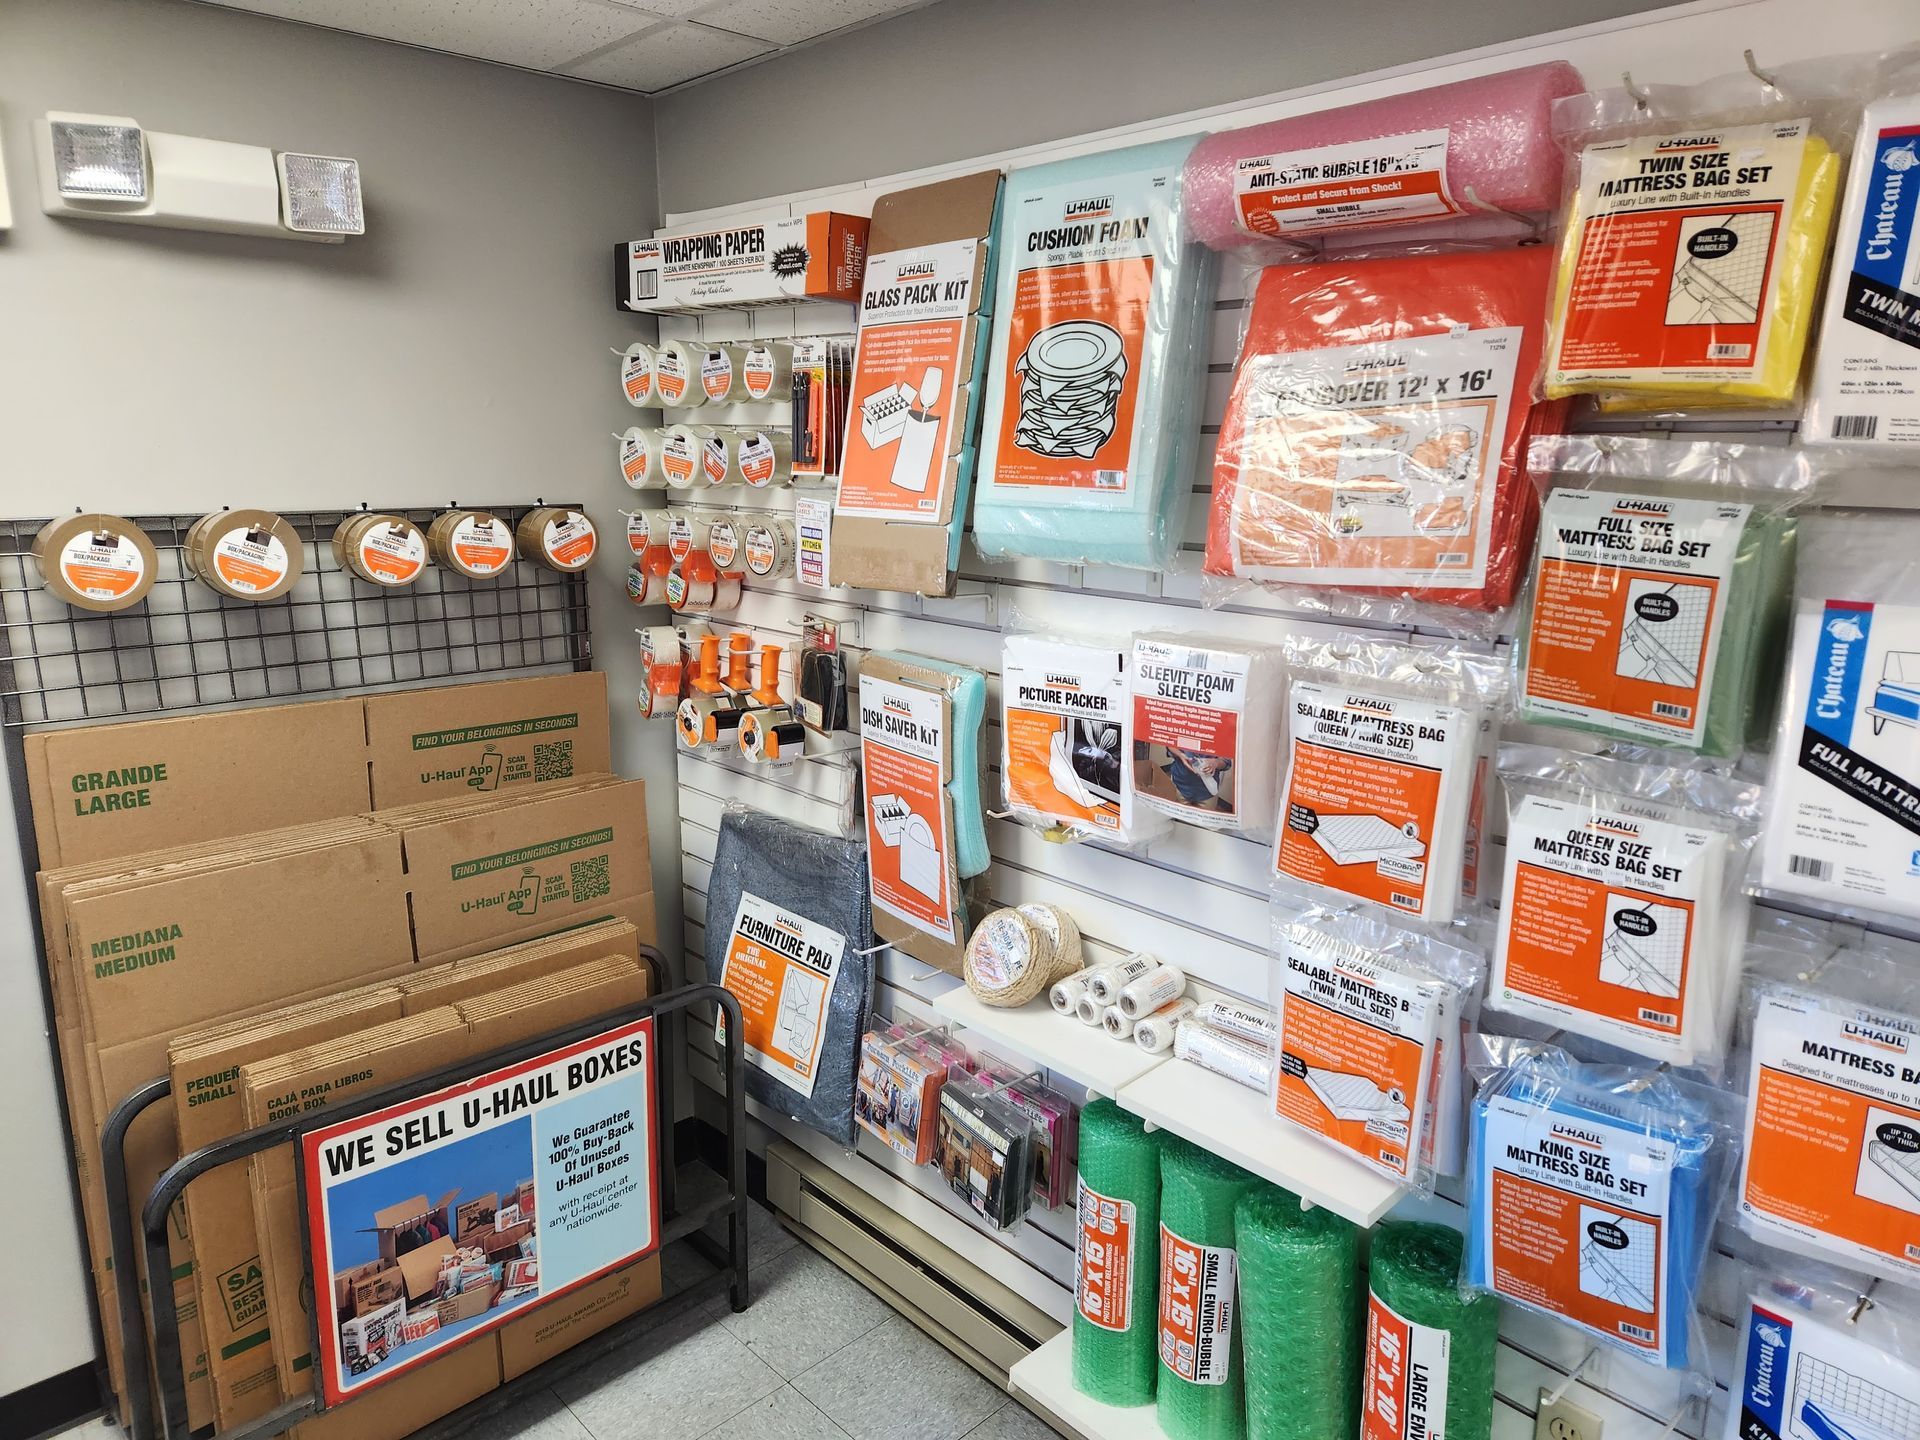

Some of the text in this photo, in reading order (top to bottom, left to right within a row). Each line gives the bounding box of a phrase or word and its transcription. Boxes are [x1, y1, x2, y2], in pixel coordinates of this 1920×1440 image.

[1658, 136, 1720, 148] U-HAUL
[1322, 160, 1370, 179] BUBBLE
[1639, 152, 1730, 174] TWIN SIZE
[1272, 182, 1402, 204] Protect and Secure from Shock!
[1599, 166, 1772, 197] MATTRESS BAG SET
[1066, 198, 1111, 215] U-HAUL
[1316, 204, 1360, 214] SMALL BUBBLE
[1866, 172, 1903, 261] Chateau
[634, 243, 660, 252] U-HAUL
[663, 228, 764, 264] WRAPPING PAPER
[1028, 216, 1149, 252] CUSHION FOAM
[678, 264, 690, 272] WHITE
[692, 261, 716, 271] NEWSPRINT
[728, 258, 744, 266] SHEETS
[746, 256, 754, 264] PER
[755, 255, 765, 263] BOX
[845, 234, 855, 288] WRAPPING
[853, 246, 862, 280] PAPER
[898, 263, 934, 276] U-HAUL
[865, 280, 968, 310] GLASS PACK KIT
[1861, 288, 1910, 320] TWIN
[1460, 370, 1492, 392] 16'
[1616, 501, 1670, 513] U-HAUL
[1598, 516, 1674, 538] FULL SIZE
[802, 540, 822, 550] KITCHEN
[1558, 528, 1710, 558] MATTRESS BAG SET
[802, 563, 822, 573] FRAGILE
[1140, 664, 1234, 692] SLEEVIT FOAM
[1158, 682, 1212, 704] SLEEVES
[1816, 641, 1849, 720] Chateau
[1019, 686, 1107, 710] PICTURE PACKER
[416, 716, 576, 747] FIND YOUR BELONGINGS IN SECONDS!
[863, 706, 938, 748] DISH SAVER KIT
[1297, 703, 1445, 742] SEALABLE MATTRESS BAG
[1314, 722, 1349, 738] (QUEEN
[1386, 736, 1414, 752] SIZE)
[469, 764, 493, 778] App
[508, 756, 526, 764] SCAN
[516, 763, 528, 772] GET
[1810, 742, 1849, 774] FULL
[71, 763, 168, 793] GRANDE
[503, 771, 531, 782] STARTED
[74, 788, 151, 817] LARGE
[1590, 817, 1639, 834] U-HAUL
[1534, 838, 1682, 882] MATTRESS BAG SET
[1566, 829, 1652, 860] QUEEN SIZE
[91, 924, 183, 958] MEDIANA
[740, 914, 832, 970] FURNITURE PAD
[94, 946, 176, 979] MEDIUM
[1124, 960, 1146, 976] TWINE
[1288, 958, 1397, 1008] SEALABLE MATTRESS
[1310, 980, 1336, 999] (TWIN
[1345, 994, 1366, 1012] FULL
[1370, 1004, 1394, 1022] SIZE)
[1844, 1024, 1904, 1048] U-HAUL
[1802, 1041, 1896, 1078] MATTRESS
[300, 1082, 332, 1100] PARA
[334, 1069, 374, 1089] LIBROS
[1782, 1059, 1910, 1102] Designed for mattresses up to
[188, 1086, 236, 1108] SMALL
[268, 1096, 328, 1122] BOOK BOX
[326, 1040, 642, 1176] WE SELL U-HAUL BOXES
[548, 1122, 635, 1165] 100% Buy-Back
[552, 1108, 630, 1148] We Guarantee
[1552, 1124, 1602, 1144] U-HAUL
[1890, 1128, 1912, 1140] UP TO
[1897, 1136, 1920, 1150] THICK
[564, 1141, 620, 1174] Of Unused
[1506, 1144, 1648, 1197] MATTRESS BAG SET
[1540, 1139, 1610, 1172] KING SIZE
[556, 1152, 630, 1192] U-Haul Boxes
[549, 1182, 638, 1229] any U-Haul center
[558, 1176, 628, 1212] with receipt at
[566, 1202, 622, 1232] nationwide.
[1082, 1233, 1104, 1318] 16" X 15'
[1172, 1249, 1198, 1336] 16" X 15'
[1199, 1254, 1218, 1380] SMALL ENVIRO-BUBBLE
[1377, 1326, 1400, 1434] 16" X 10'
[1411, 1363, 1428, 1414] LARGE
[1752, 1344, 1774, 1408] Chateau
